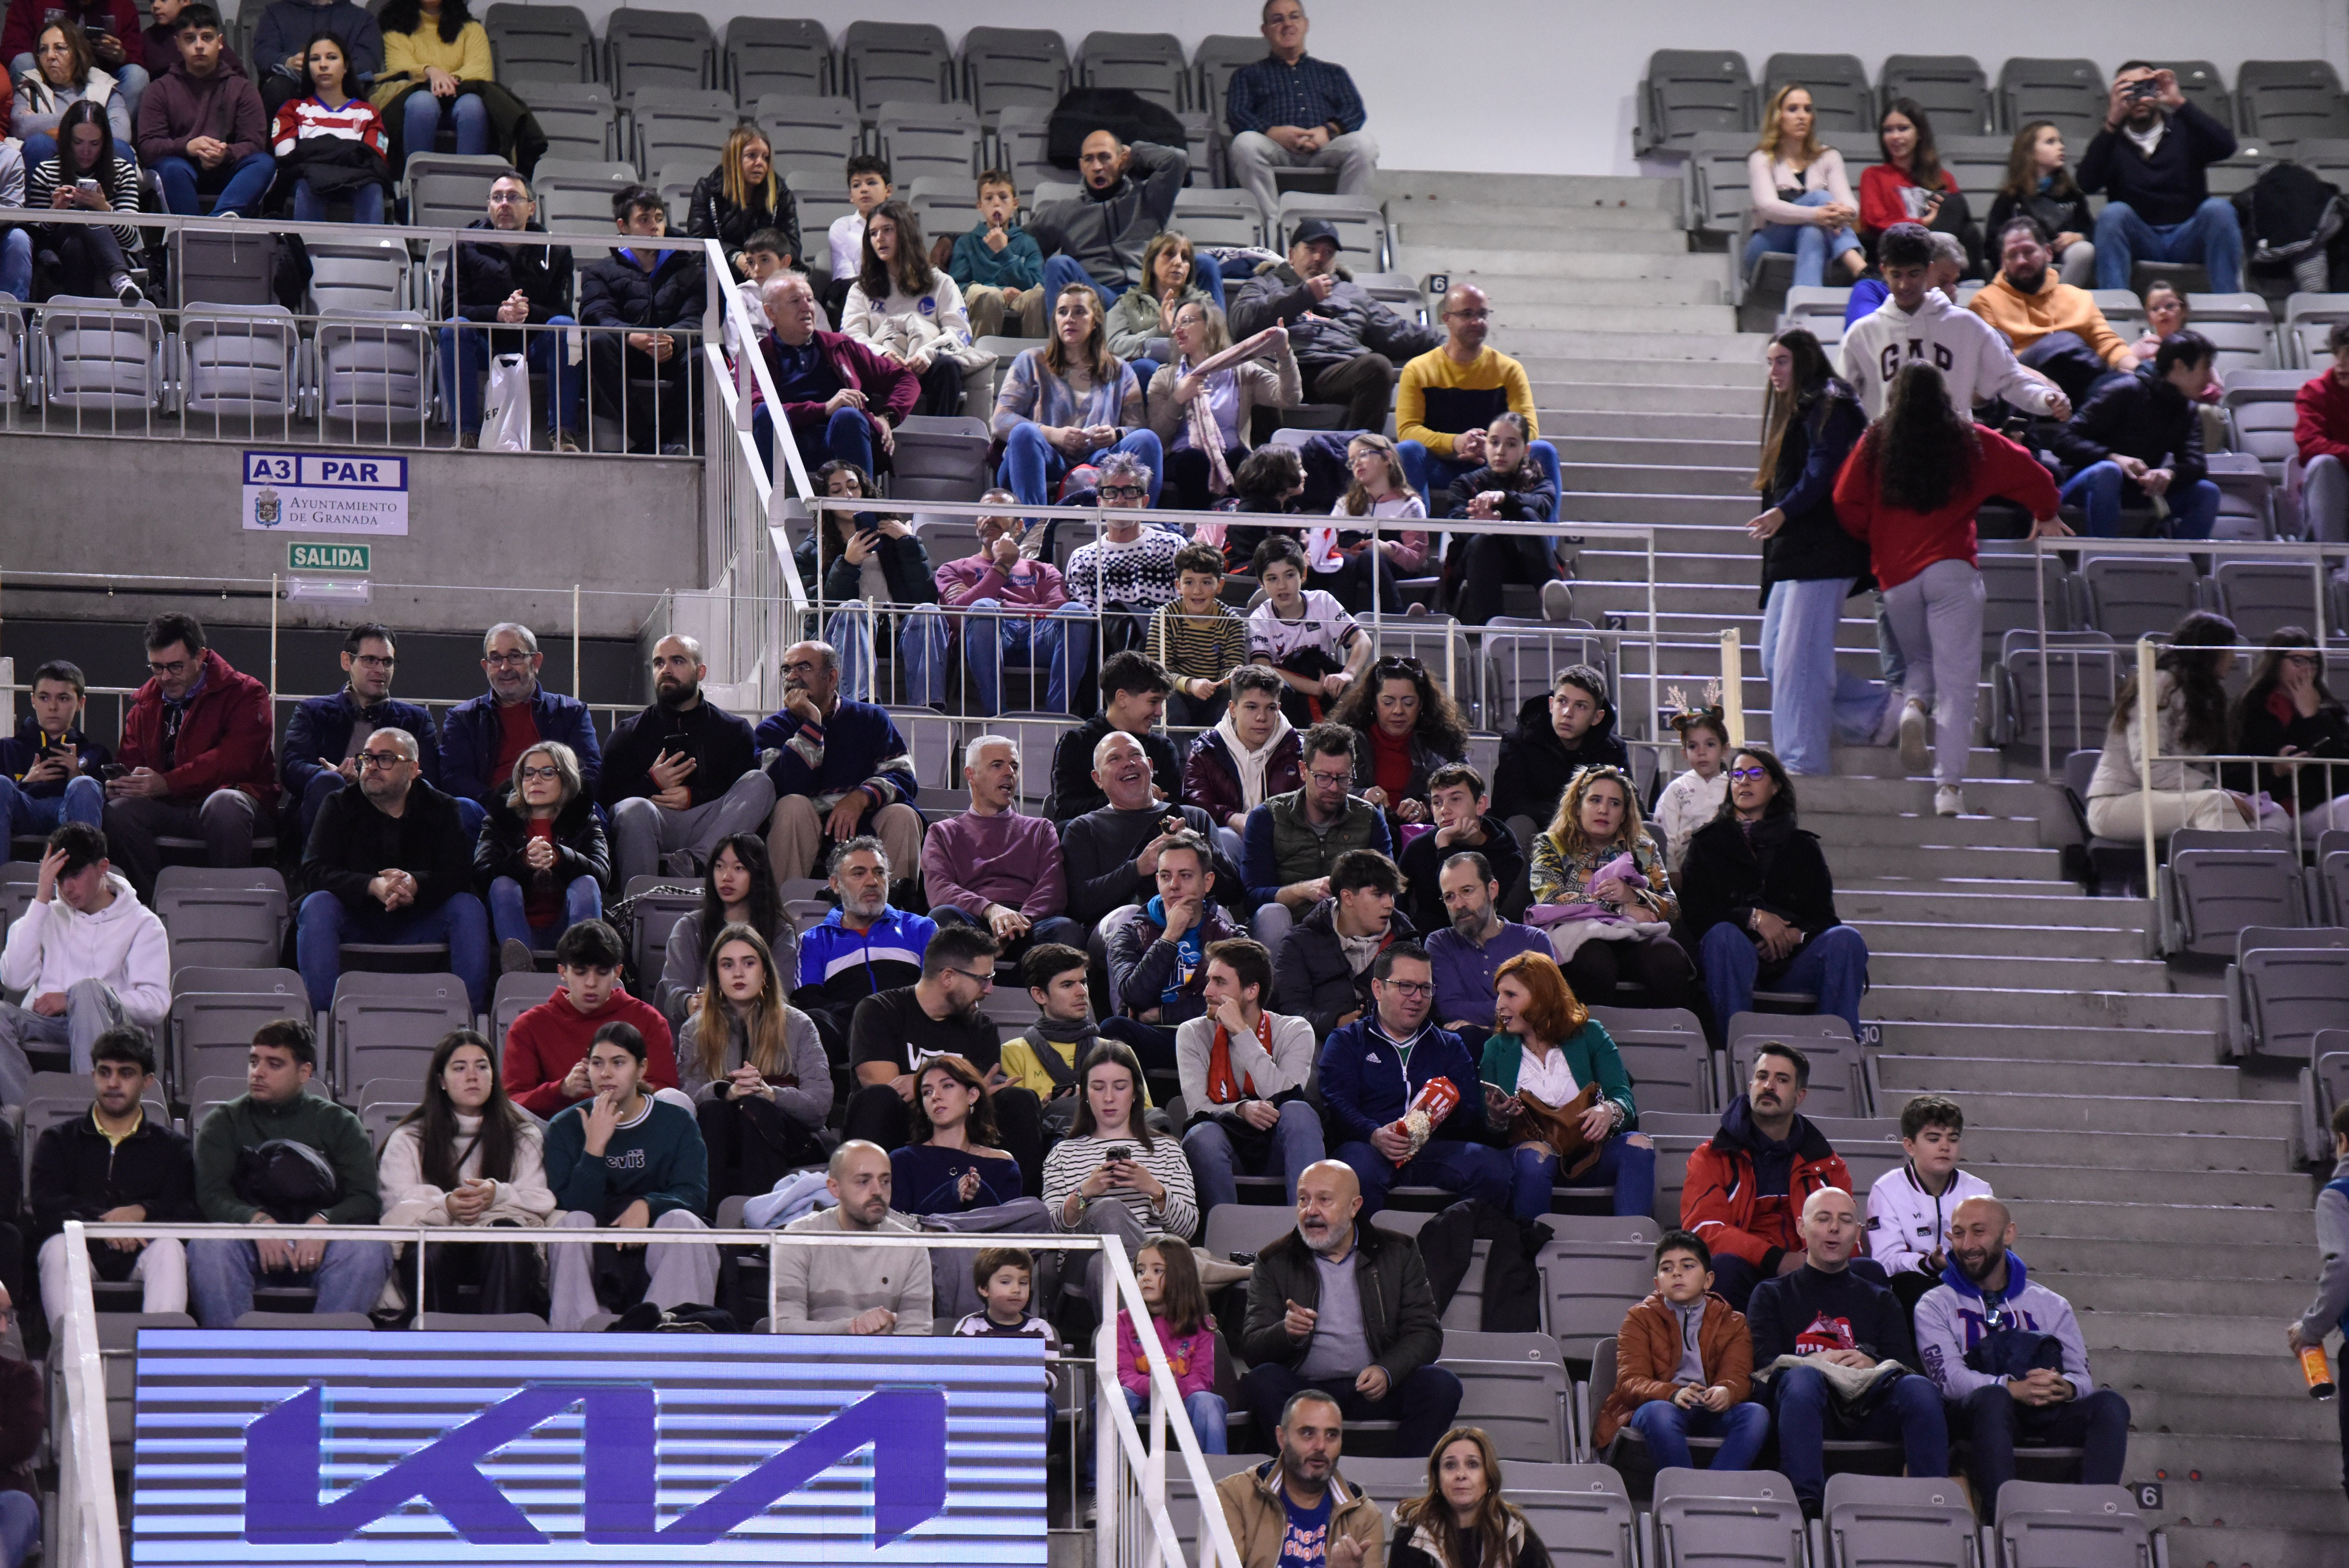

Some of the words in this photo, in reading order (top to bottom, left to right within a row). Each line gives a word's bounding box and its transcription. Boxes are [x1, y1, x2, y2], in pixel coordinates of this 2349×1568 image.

[1432, 277, 1446, 292] 6
[1881, 338, 1953, 381] GAP
[253, 459, 291, 479] A3
[321, 461, 379, 482] PAR
[290, 496, 397, 513] AYUNTAMIENTO
[290, 512, 306, 522] DE
[312, 511, 378, 525] GRANADA
[295, 547, 364, 567] SALIDA
[1611, 617, 1622, 631] 2
[1664, 714, 1670, 728] 1
[1862, 1026, 1879, 1042] 10
[244, 1379, 947, 1551] KIA
[2142, 1486, 2157, 1506] 6
